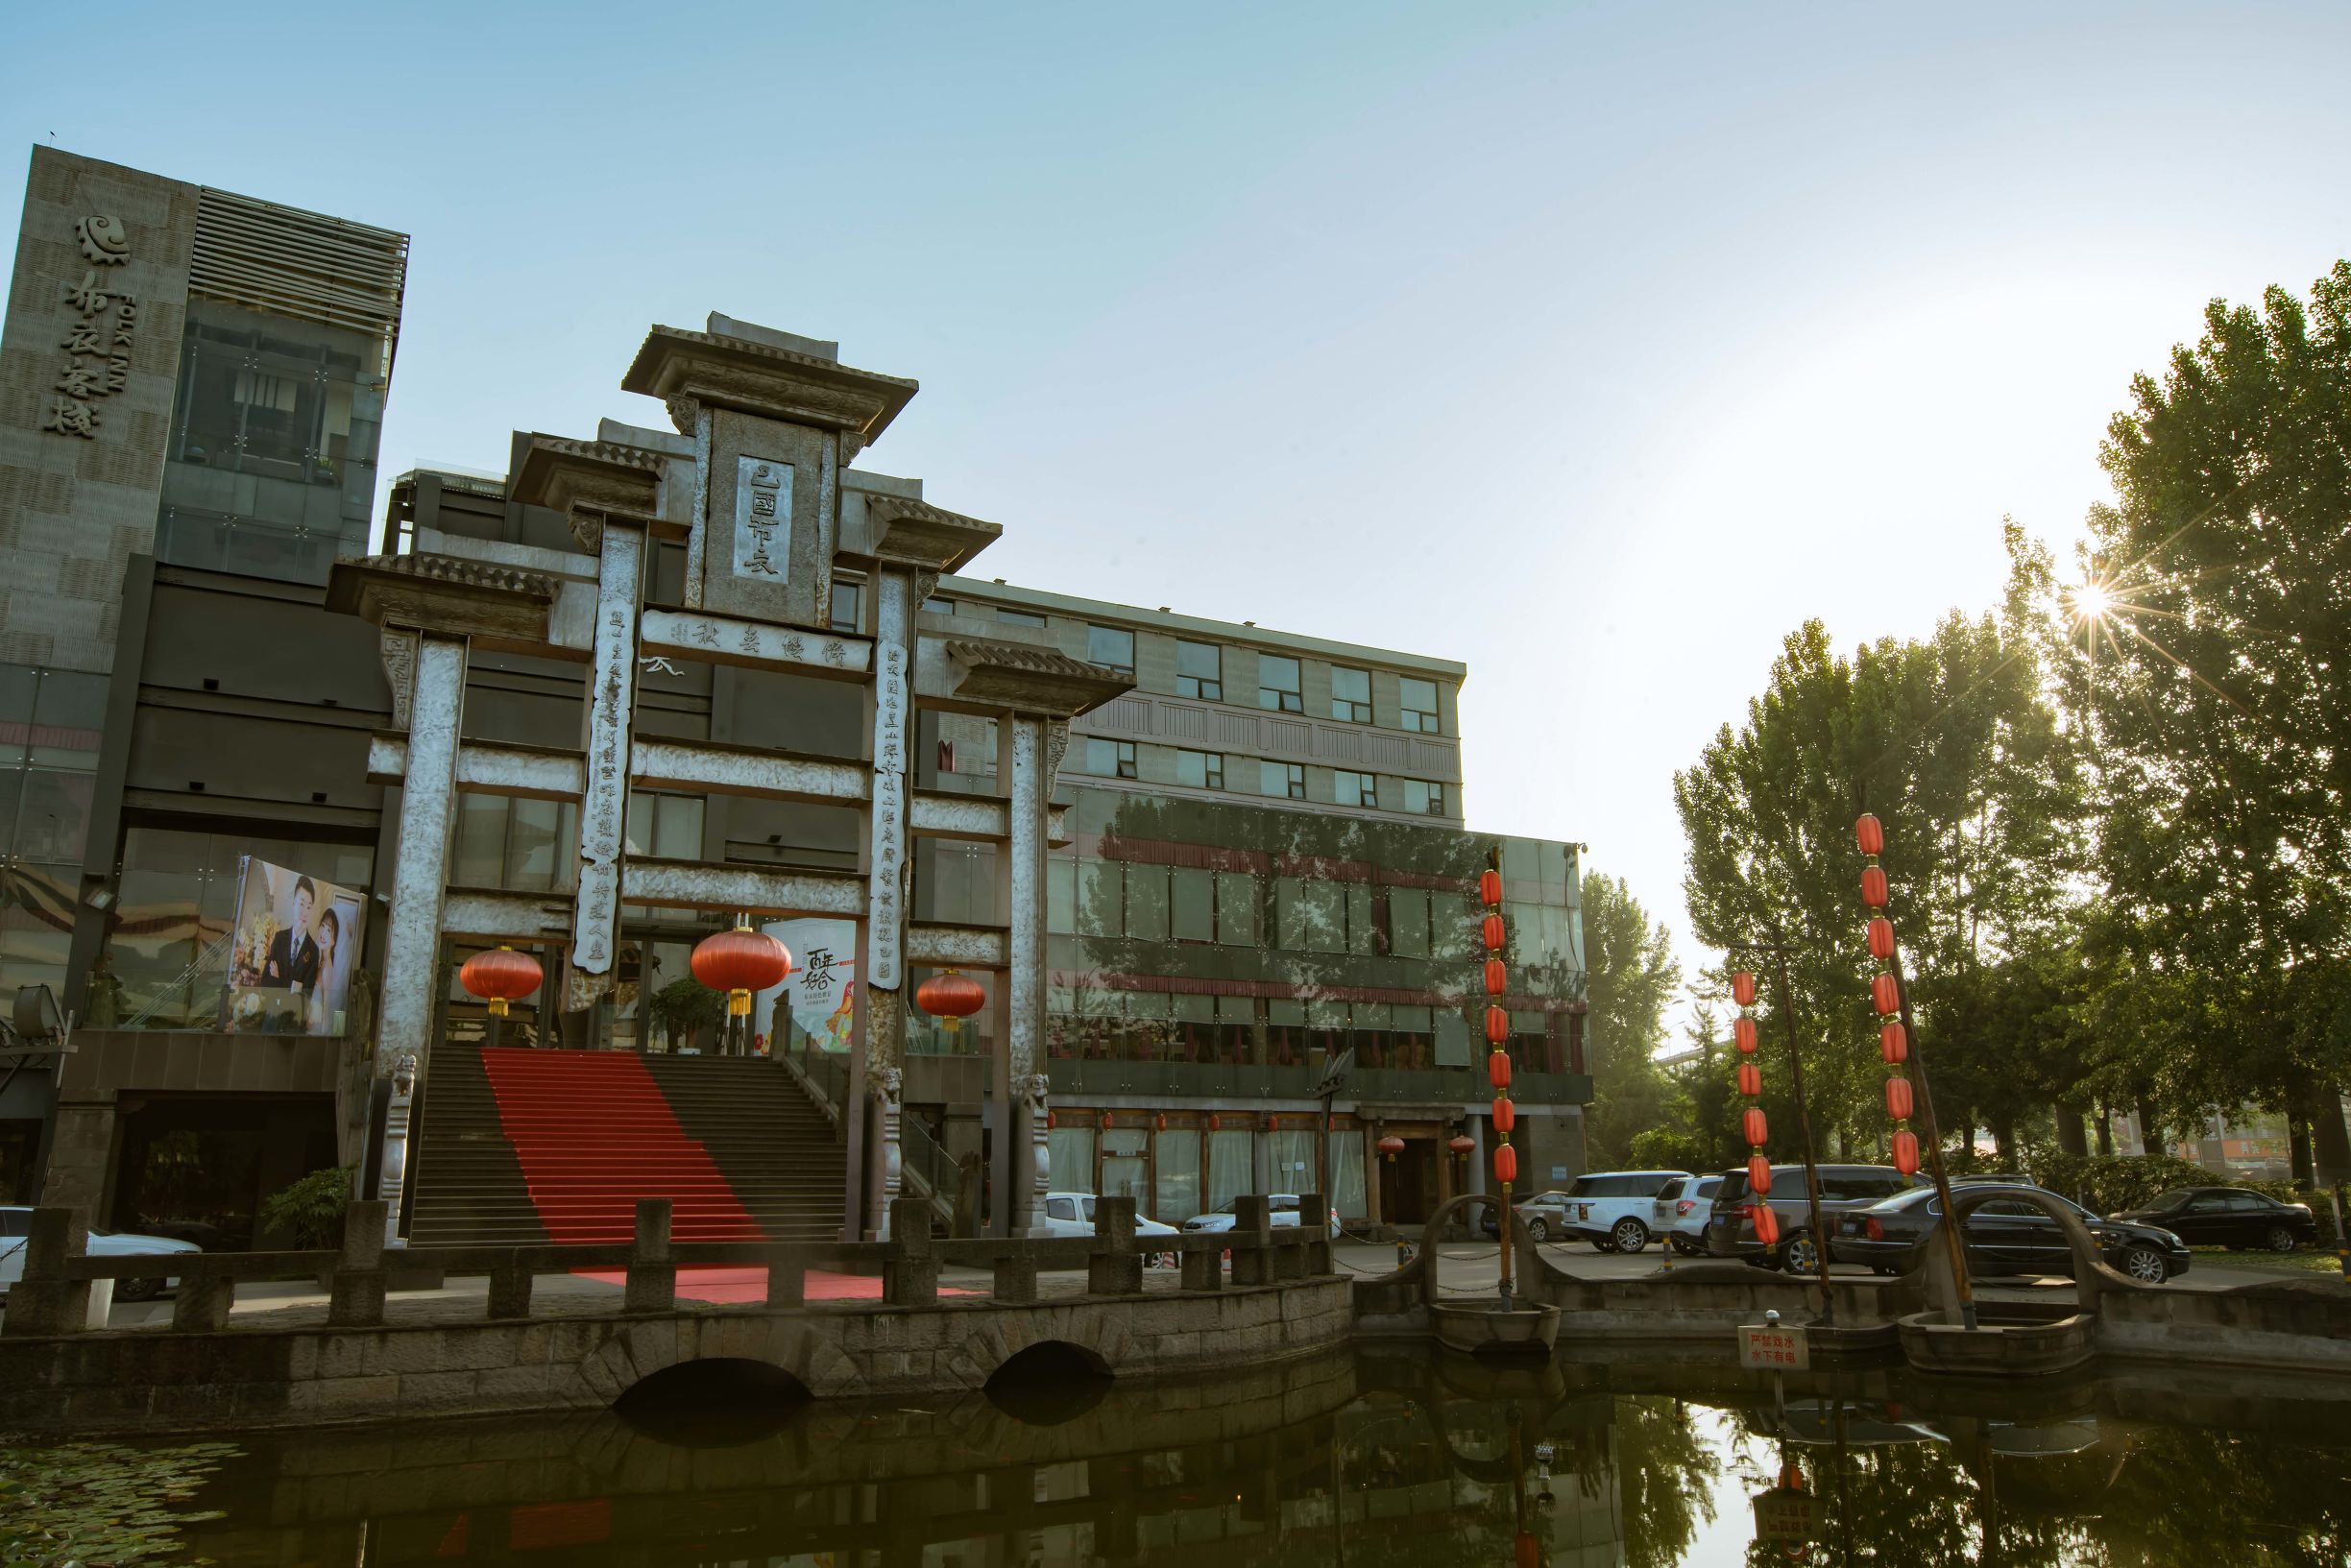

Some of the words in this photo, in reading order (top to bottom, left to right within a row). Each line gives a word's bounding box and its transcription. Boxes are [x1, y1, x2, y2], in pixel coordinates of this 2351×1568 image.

[114, 294, 137, 347] FOLK
[44, 270, 116, 438] 布衣客栈
[108, 351, 129, 393] INN
[807, 947, 838, 971] 百年
[800, 970, 836, 991] 好合
[1750, 1335, 1795, 1349] 严禁戏水
[1751, 1350, 1797, 1364] 水下有电
